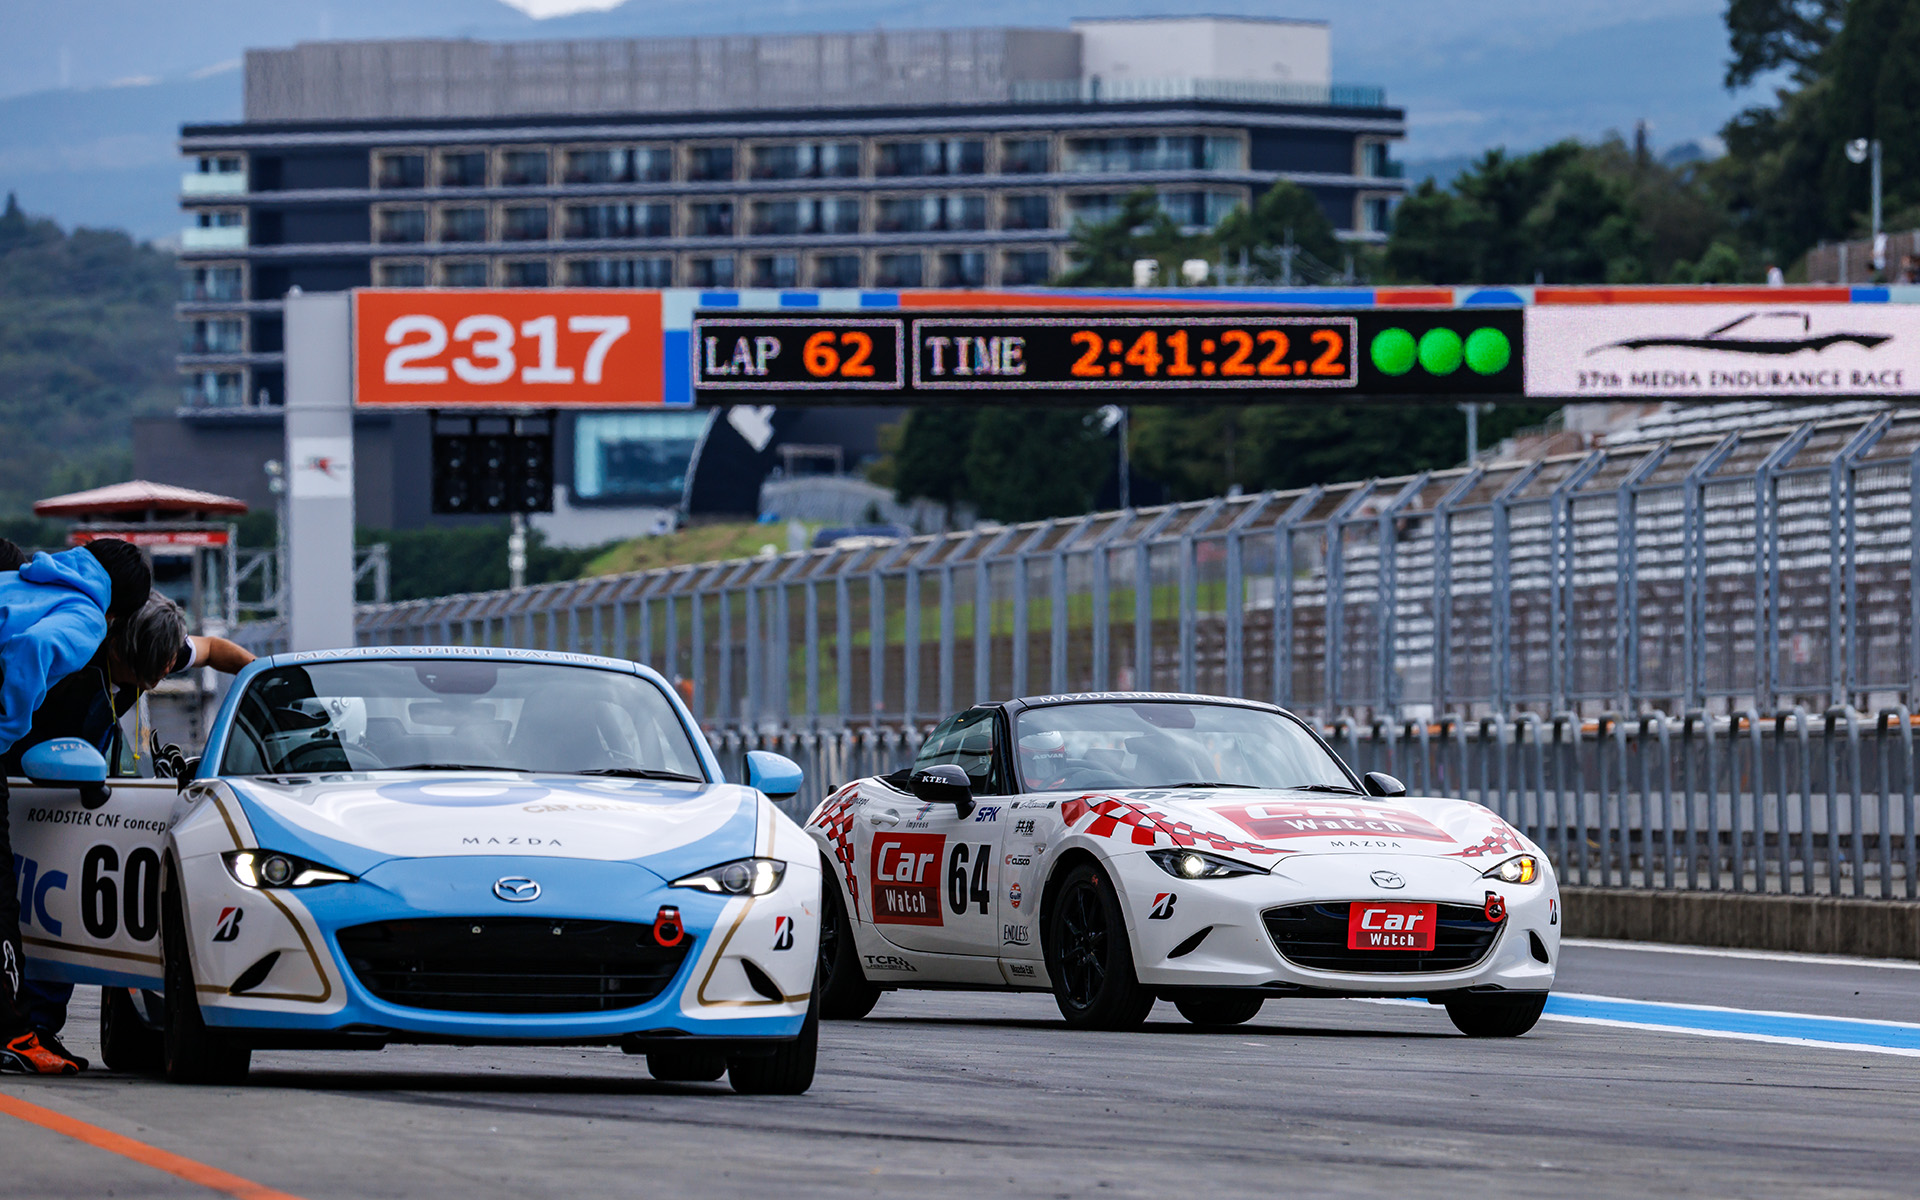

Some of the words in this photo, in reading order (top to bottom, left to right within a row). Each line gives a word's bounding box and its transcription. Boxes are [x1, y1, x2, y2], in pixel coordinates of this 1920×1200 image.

[384, 314, 630, 384] 2317
[704, 336, 781, 376] LAP
[803, 331, 875, 377] 62
[926, 336, 1026, 375] TIME
[1070, 329, 1345, 377] 2:41:22.2
[1629, 369, 1700, 387] MEDIA
[1710, 369, 1840, 387] ENDURANCE
[1851, 369, 1904, 387] RACE
[293, 647, 400, 661] MAZDA
[409, 646, 495, 657] SPIRIT
[506, 649, 611, 666] RACING
[1040, 692, 1115, 703] MAZDA
[1122, 691, 1180, 700] SPIRIT
[922, 776, 948, 784] KTEL
[523, 804, 575, 814] CAR
[975, 806, 1001, 822] SPK
[1244, 804, 1399, 819] Car
[28, 808, 91, 826] ROADSTER
[95, 813, 121, 828] CNF
[124, 818, 167, 835] concep
[1284, 819, 1406, 833] Watch
[462, 837, 563, 847] MAZDA
[1330, 840, 1402, 849] MAZDA
[877, 842, 935, 883] Car
[1012, 857, 1031, 866] CUSCO
[948, 842, 992, 915] 64
[81, 844, 162, 942] 60
[886, 889, 926, 914] Watch
[1361, 909, 1424, 931] Car
[1003, 924, 1029, 942] ENDLESS
[1370, 932, 1415, 946] Watch
[864, 955, 899, 965] TCR
